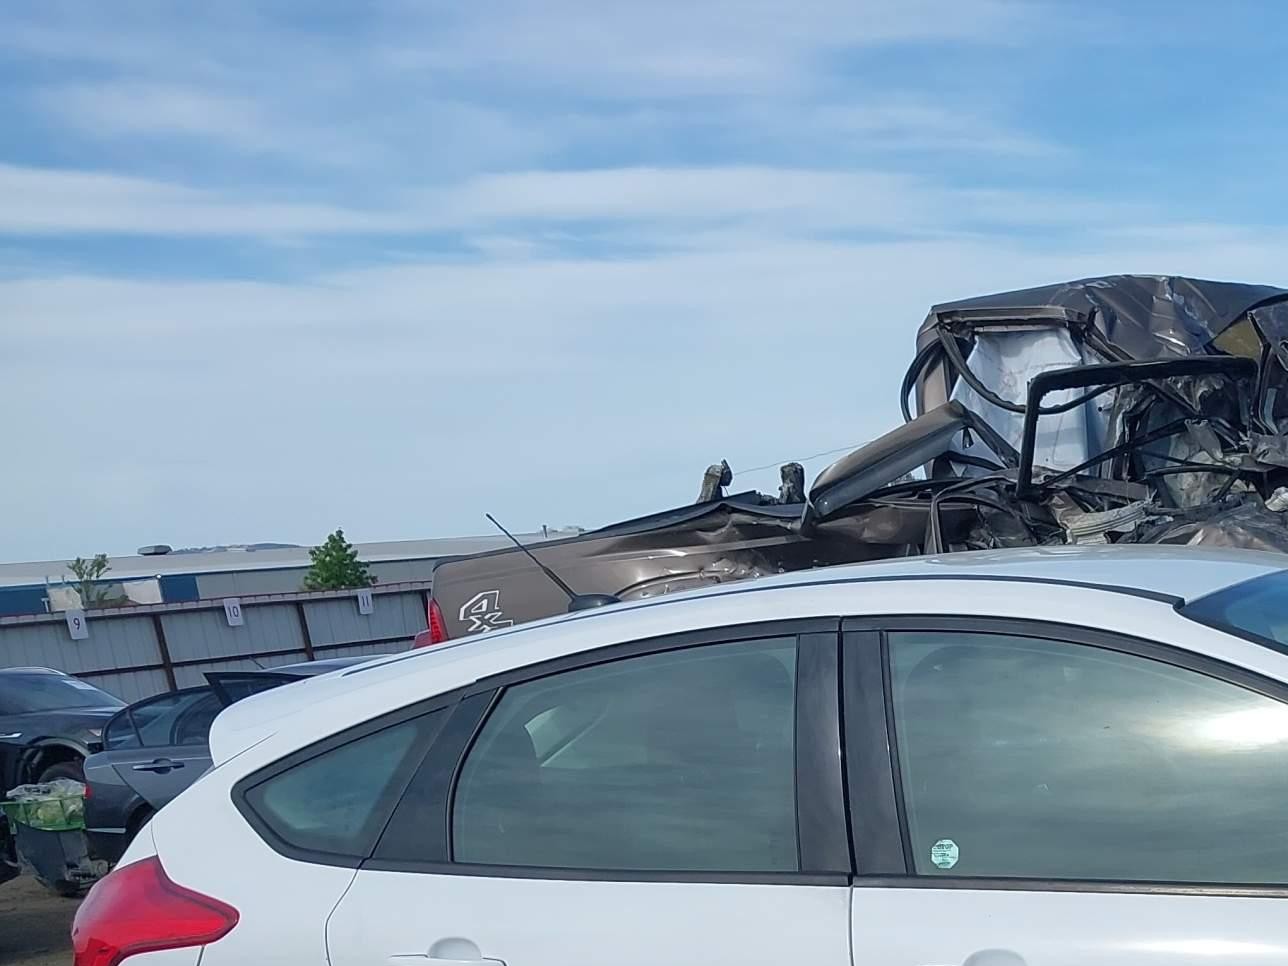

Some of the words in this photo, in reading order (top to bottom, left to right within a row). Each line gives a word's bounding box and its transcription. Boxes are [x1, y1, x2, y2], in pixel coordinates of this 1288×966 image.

[361, 594, 370, 607] 11
[227, 605, 239, 618] 10
[73, 617, 81, 630] 9
